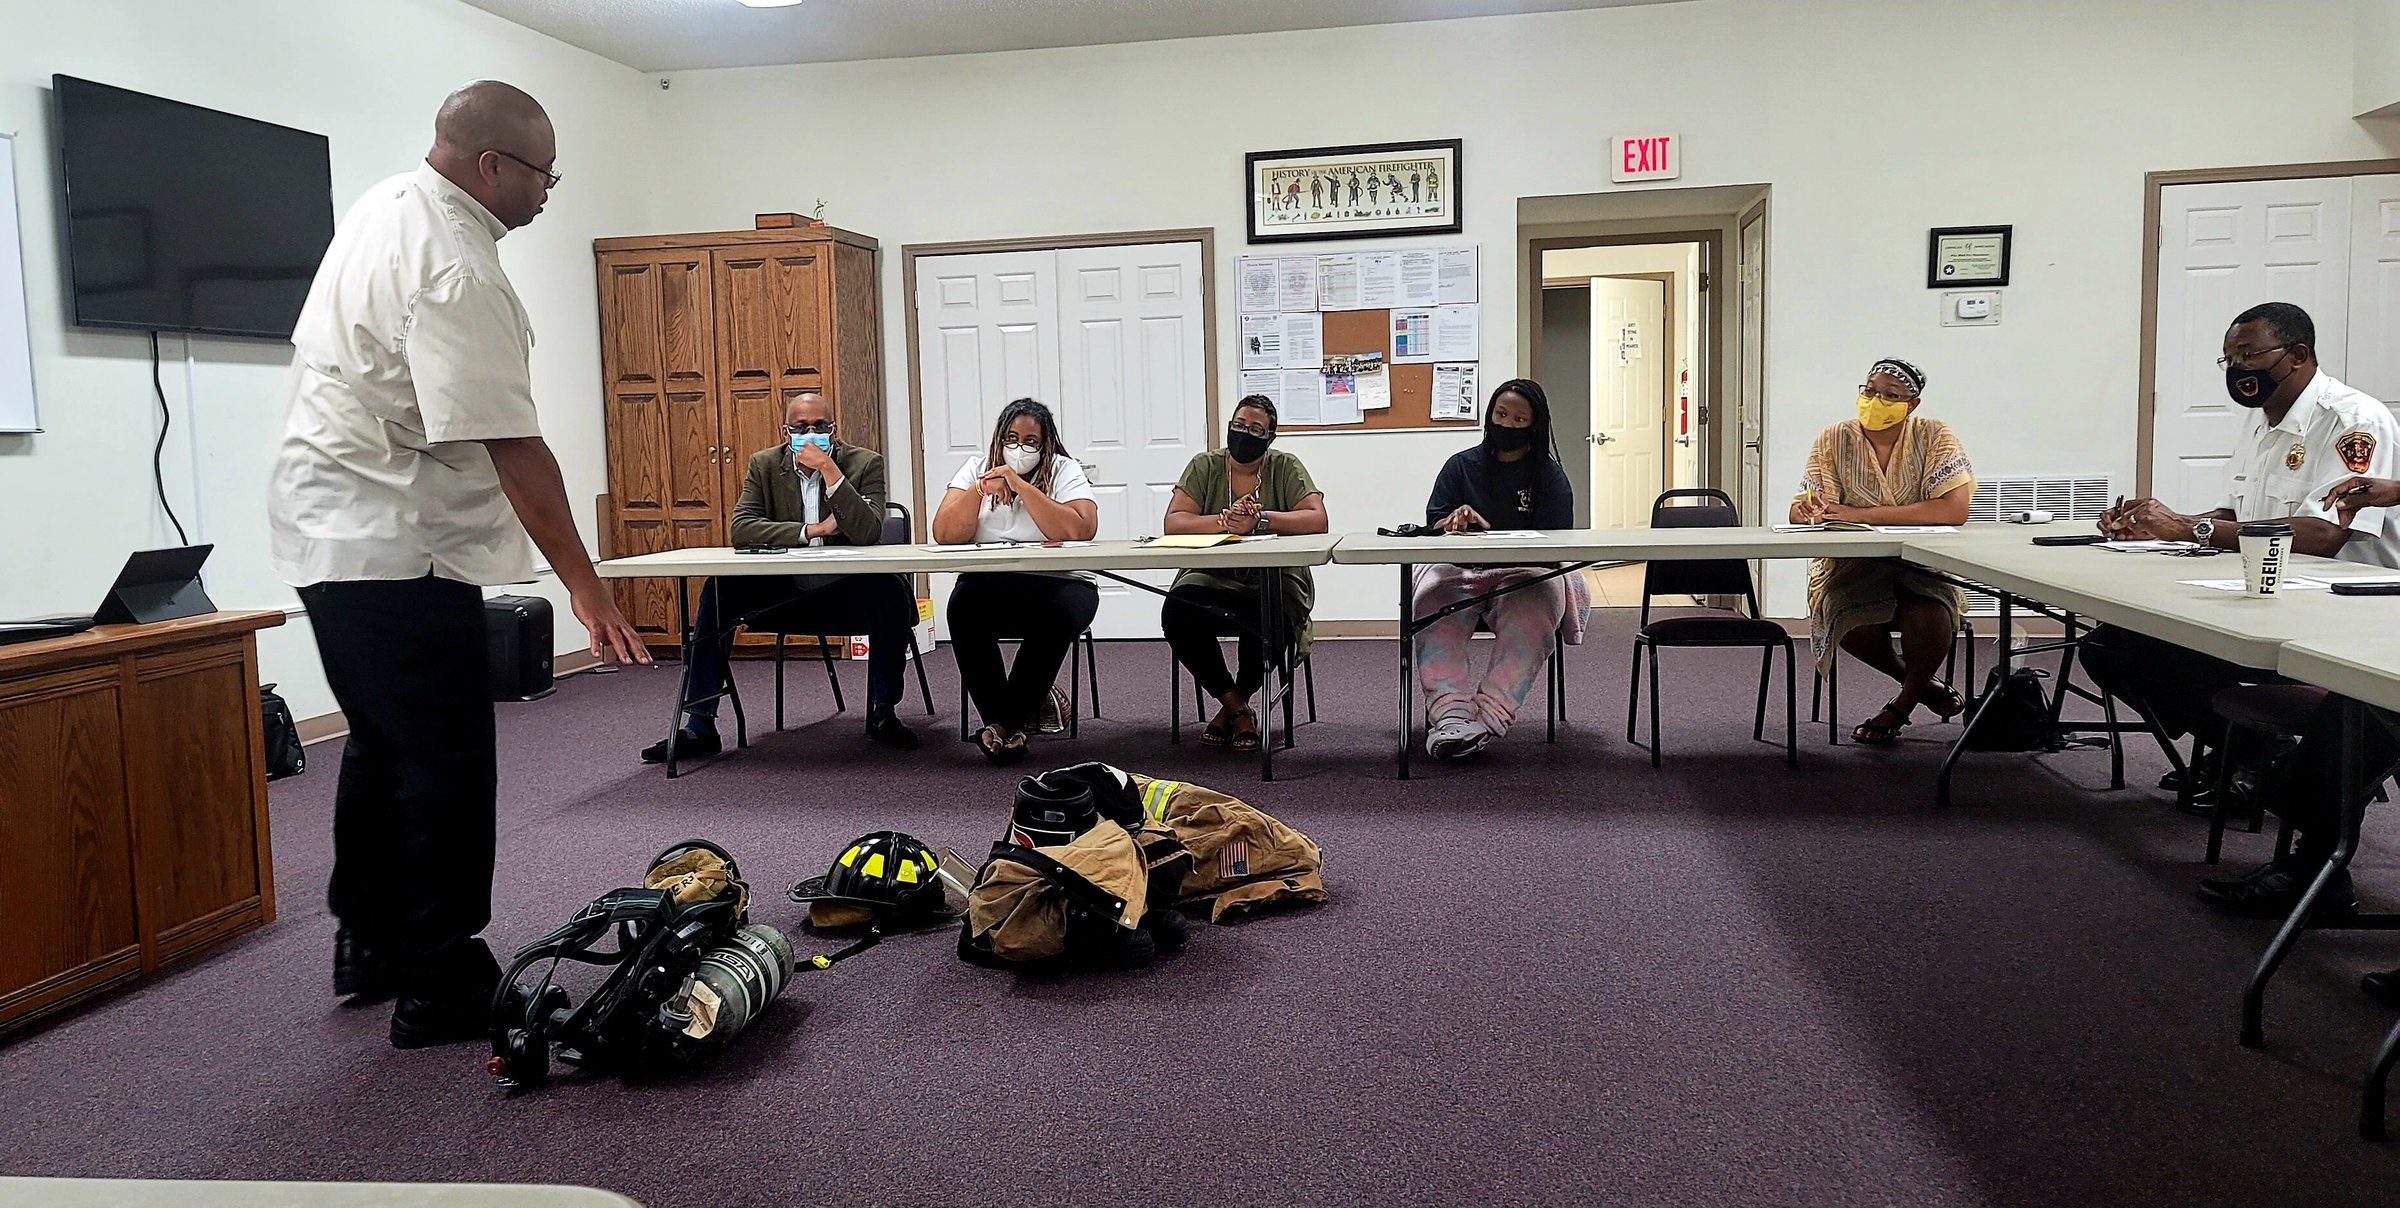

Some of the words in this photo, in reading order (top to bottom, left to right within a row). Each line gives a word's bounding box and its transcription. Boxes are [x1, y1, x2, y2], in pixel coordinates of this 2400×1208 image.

[1623, 137, 1670, 173] EXIT
[1272, 168, 1310, 178] HISTORY
[1328, 164, 1377, 176] AMERICAN
[1379, 161, 1434, 173] FIREFIGHTER
[702, 952, 751, 979] MSA
